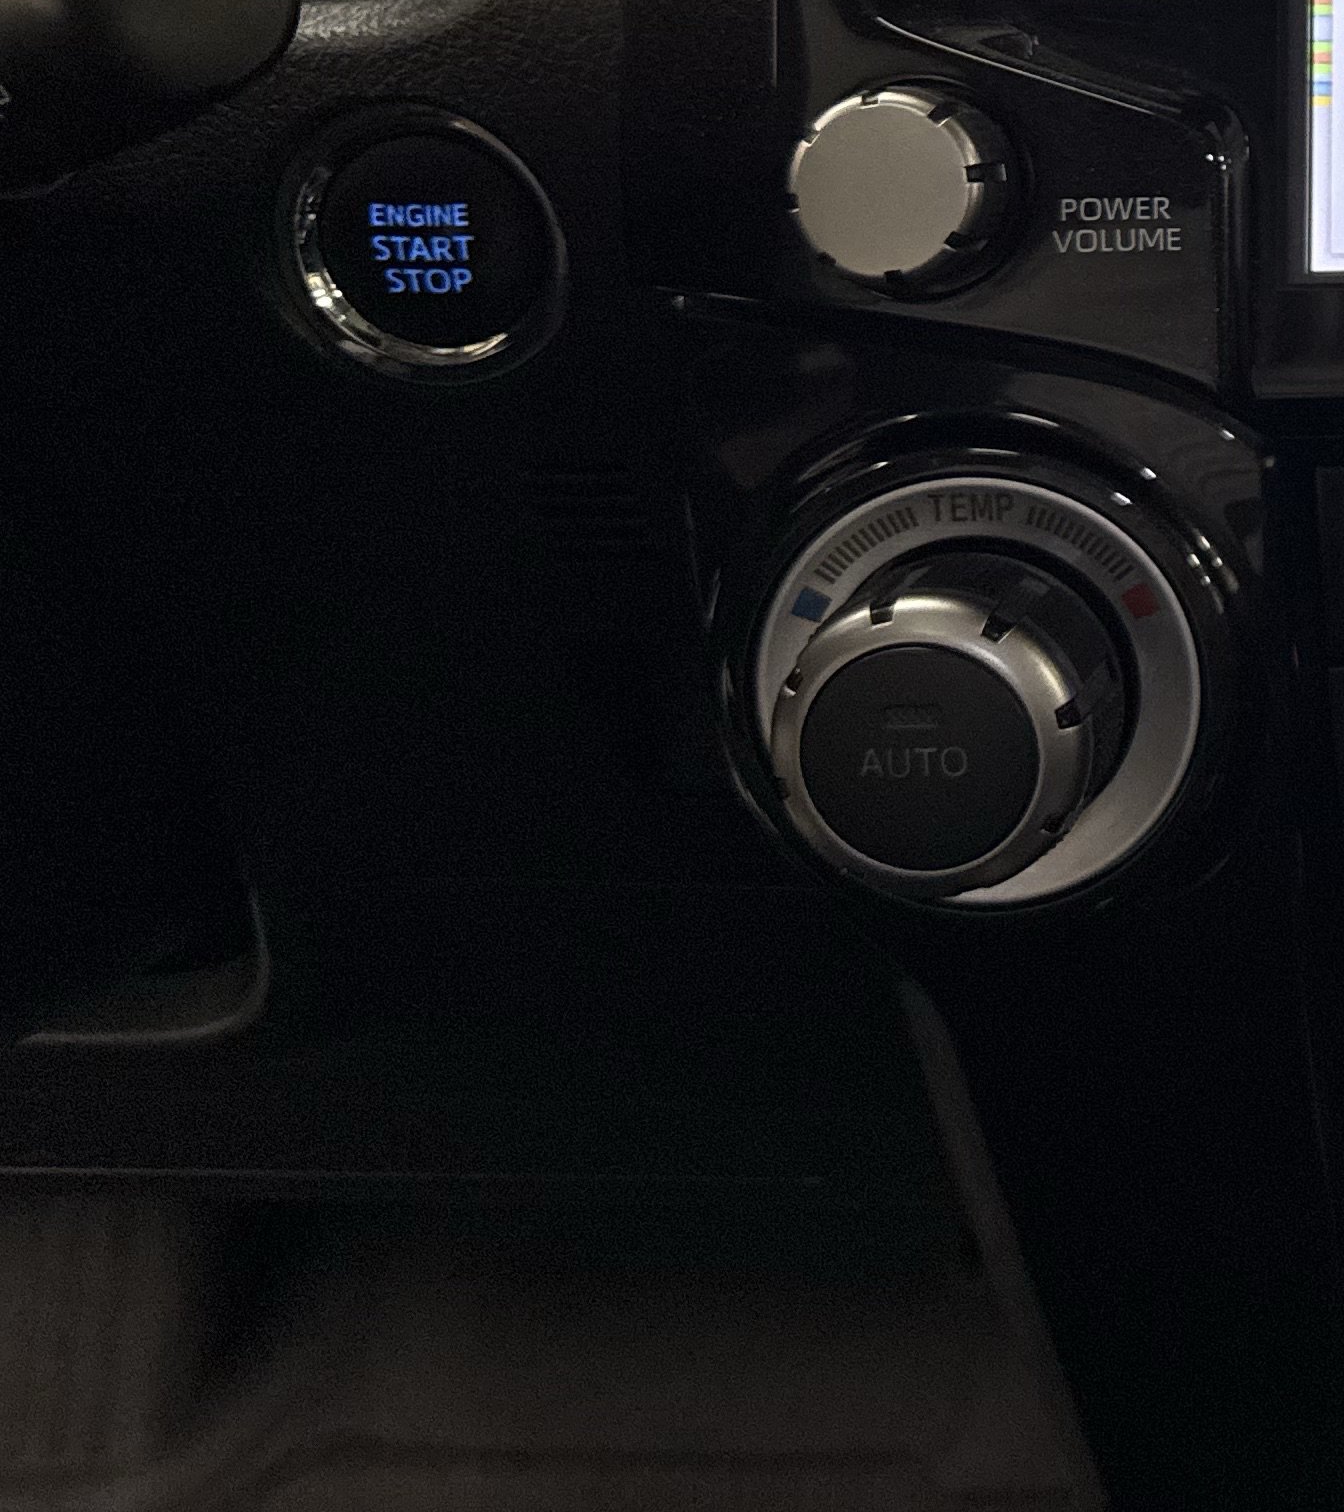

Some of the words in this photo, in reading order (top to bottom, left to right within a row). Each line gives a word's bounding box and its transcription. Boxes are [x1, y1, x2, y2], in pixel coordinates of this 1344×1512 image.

[368, 202, 469, 227] ENGINE
[1060, 196, 1172, 222] POWER
[371, 235, 474, 262] START
[1051, 227, 1182, 253] VOLUME
[384, 267, 473, 294] STOP
[927, 493, 1014, 524] TEMP
[860, 746, 969, 778] AUTO
